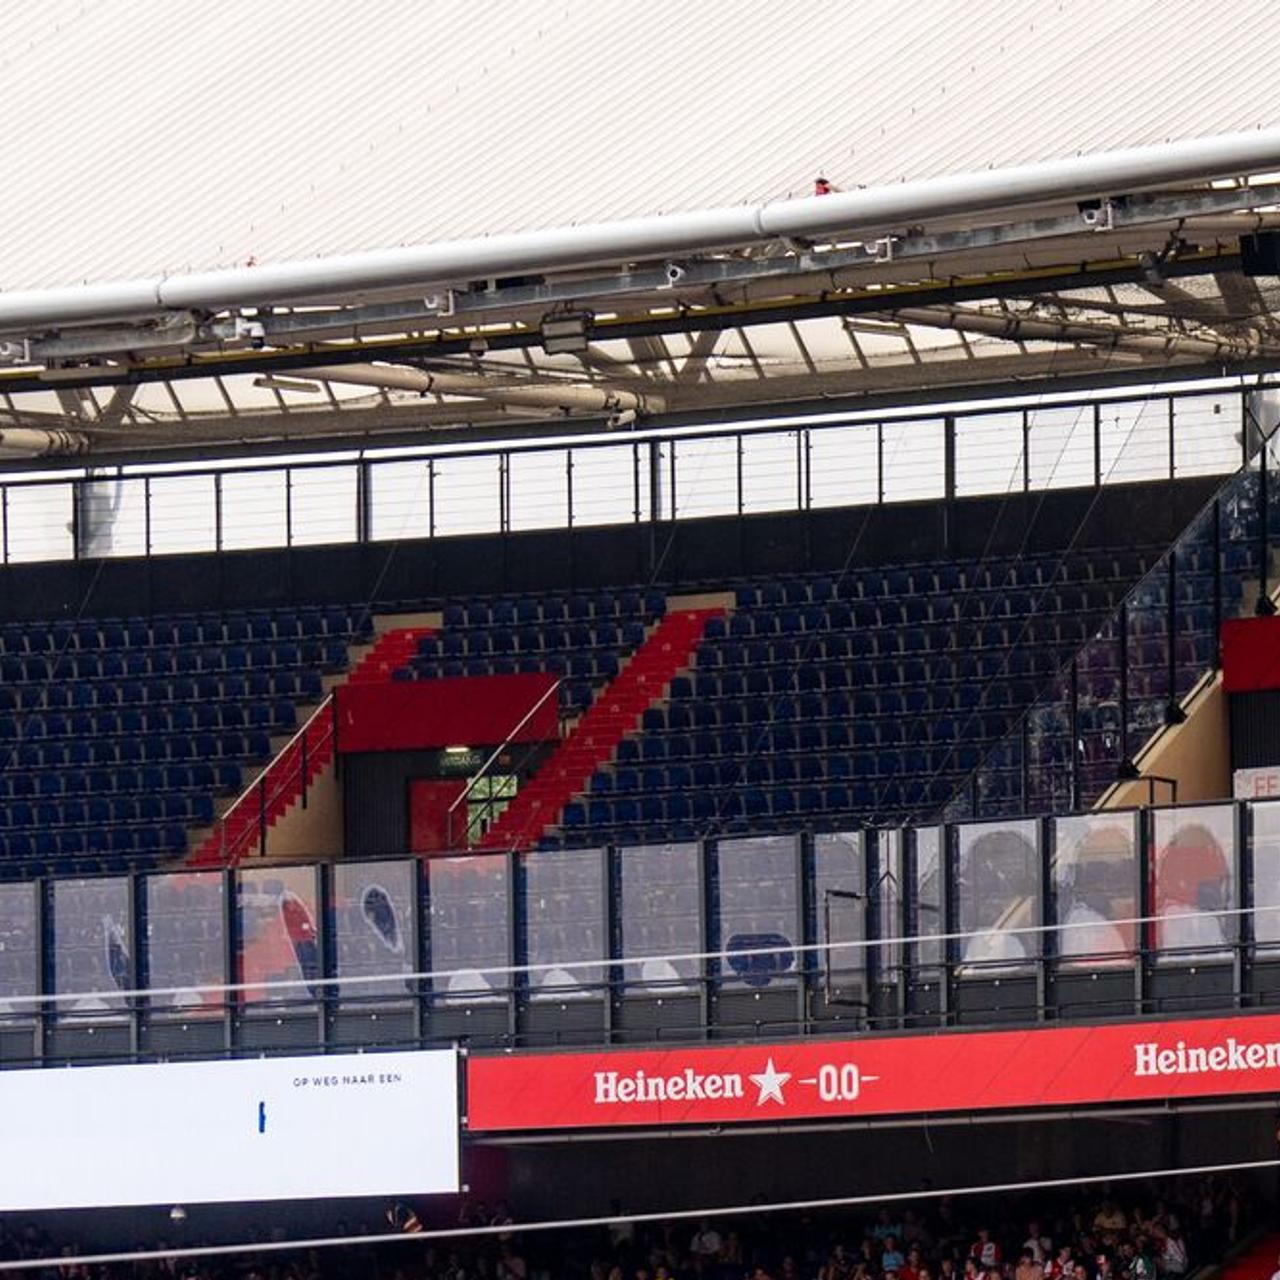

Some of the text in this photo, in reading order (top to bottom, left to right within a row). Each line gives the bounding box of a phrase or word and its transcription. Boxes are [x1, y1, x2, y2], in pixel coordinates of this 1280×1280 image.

[293, 1078, 308, 1087] OP
[313, 1076, 338, 1086] WEG
[343, 1074, 375, 1085] NAAR
[594, 1069, 743, 1104] Heineken
